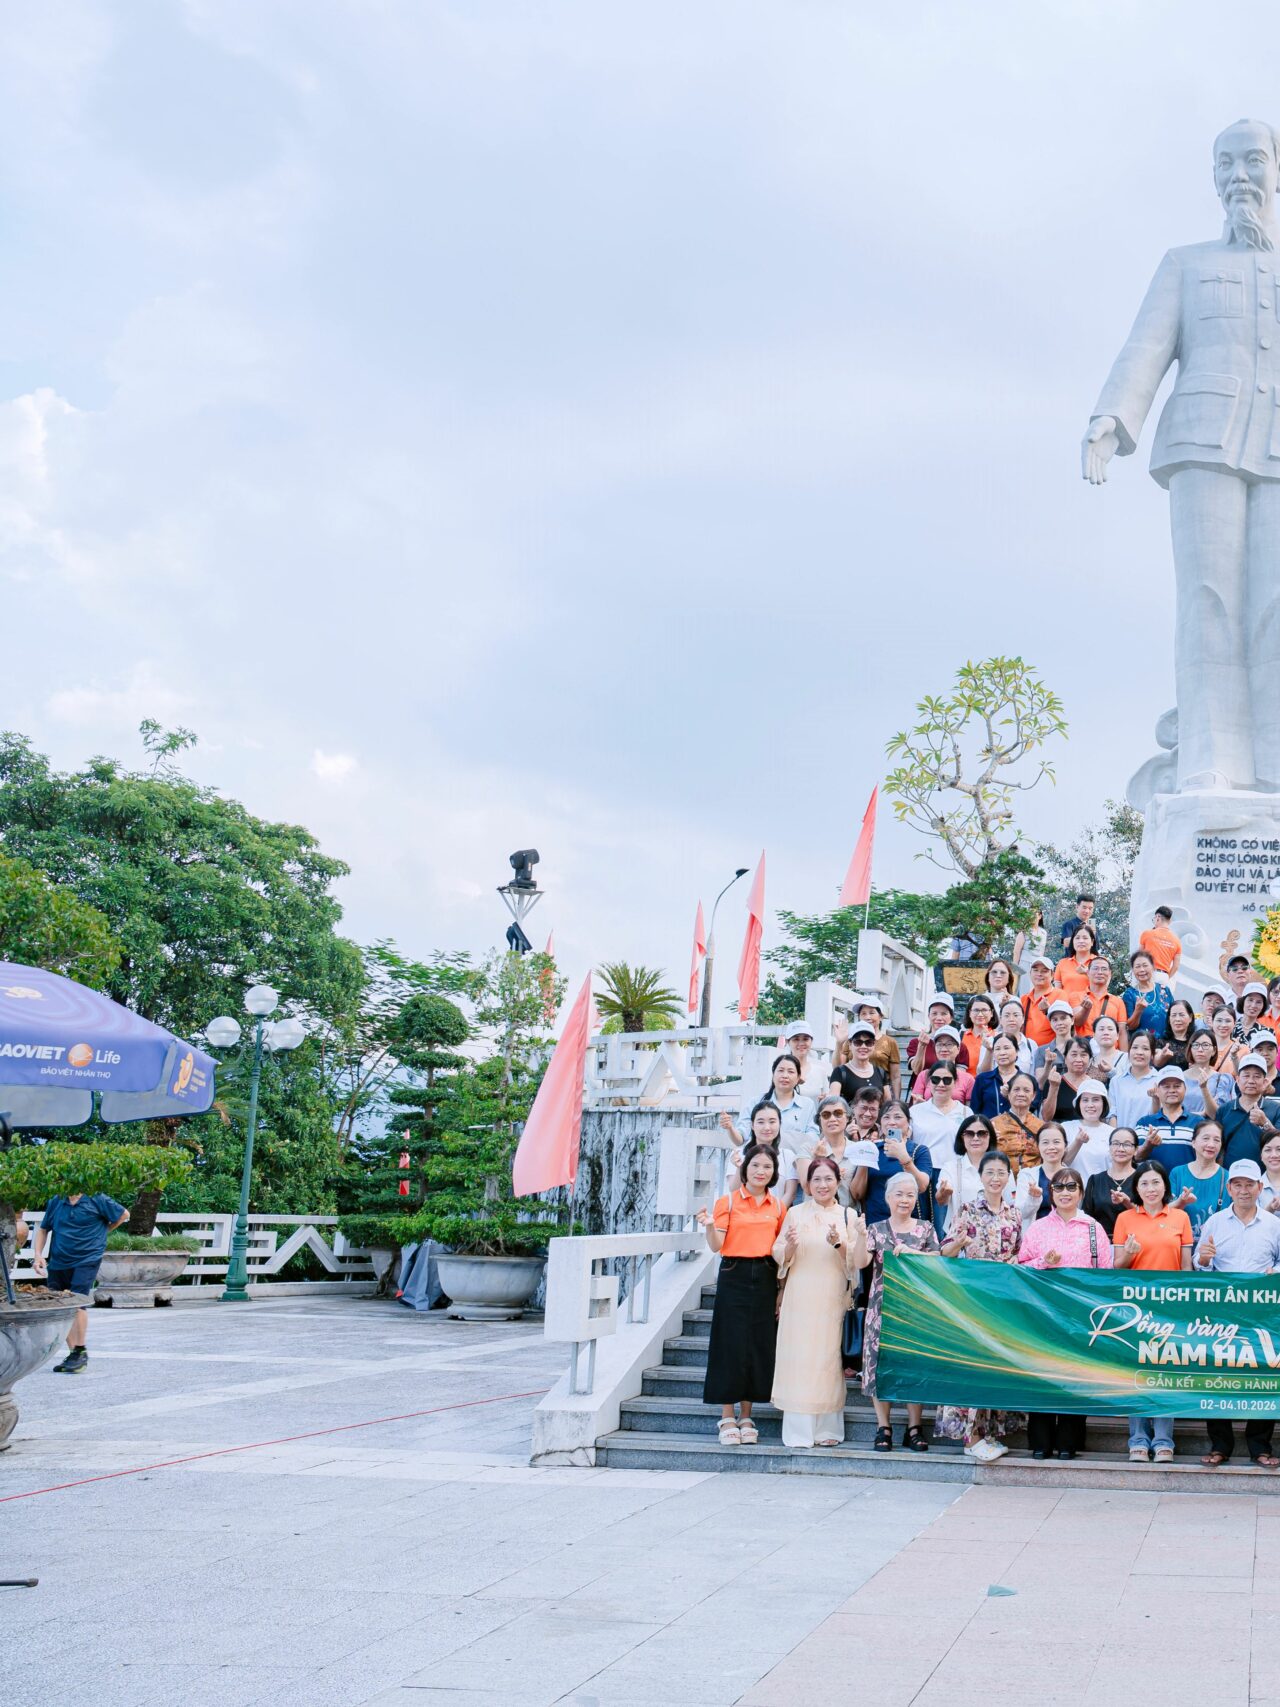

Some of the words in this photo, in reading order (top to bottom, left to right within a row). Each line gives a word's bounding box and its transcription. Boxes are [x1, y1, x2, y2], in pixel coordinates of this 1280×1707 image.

[1197, 836, 1237, 849] KHÔNG
[1241, 837, 1259, 850] CÓ
[1219, 853, 1235, 866] SỢ
[1238, 851, 1269, 865] LÒNG
[1195, 864, 1221, 877] ĐÀO
[1226, 864, 1245, 879] NÚI
[1249, 866, 1264, 879] VÀ
[1195, 879, 1235, 893] QUYẾT
[1237, 880, 1257, 893] CHÍ
[0, 1043, 66, 1060] AOVIET
[95, 1049, 121, 1064] Life
[1122, 1286, 1147, 1300] DU
[1151, 1287, 1190, 1304] LỊCH
[1191, 1288, 1220, 1303] TRI
[1224, 1285, 1249, 1303] ÂN
[1088, 1302, 1185, 1351] Rồng
[1186, 1315, 1249, 1351] vàng
[1138, 1340, 1208, 1366] NAM
[1214, 1339, 1258, 1368] HÀ
[1176, 1375, 1195, 1388] KẾT
[1204, 1376, 1242, 1390] ĐỒNG
[1244, 1378, 1278, 1390] HÀNH
[1200, 1399, 1276, 1411] 02-04.10.2026
